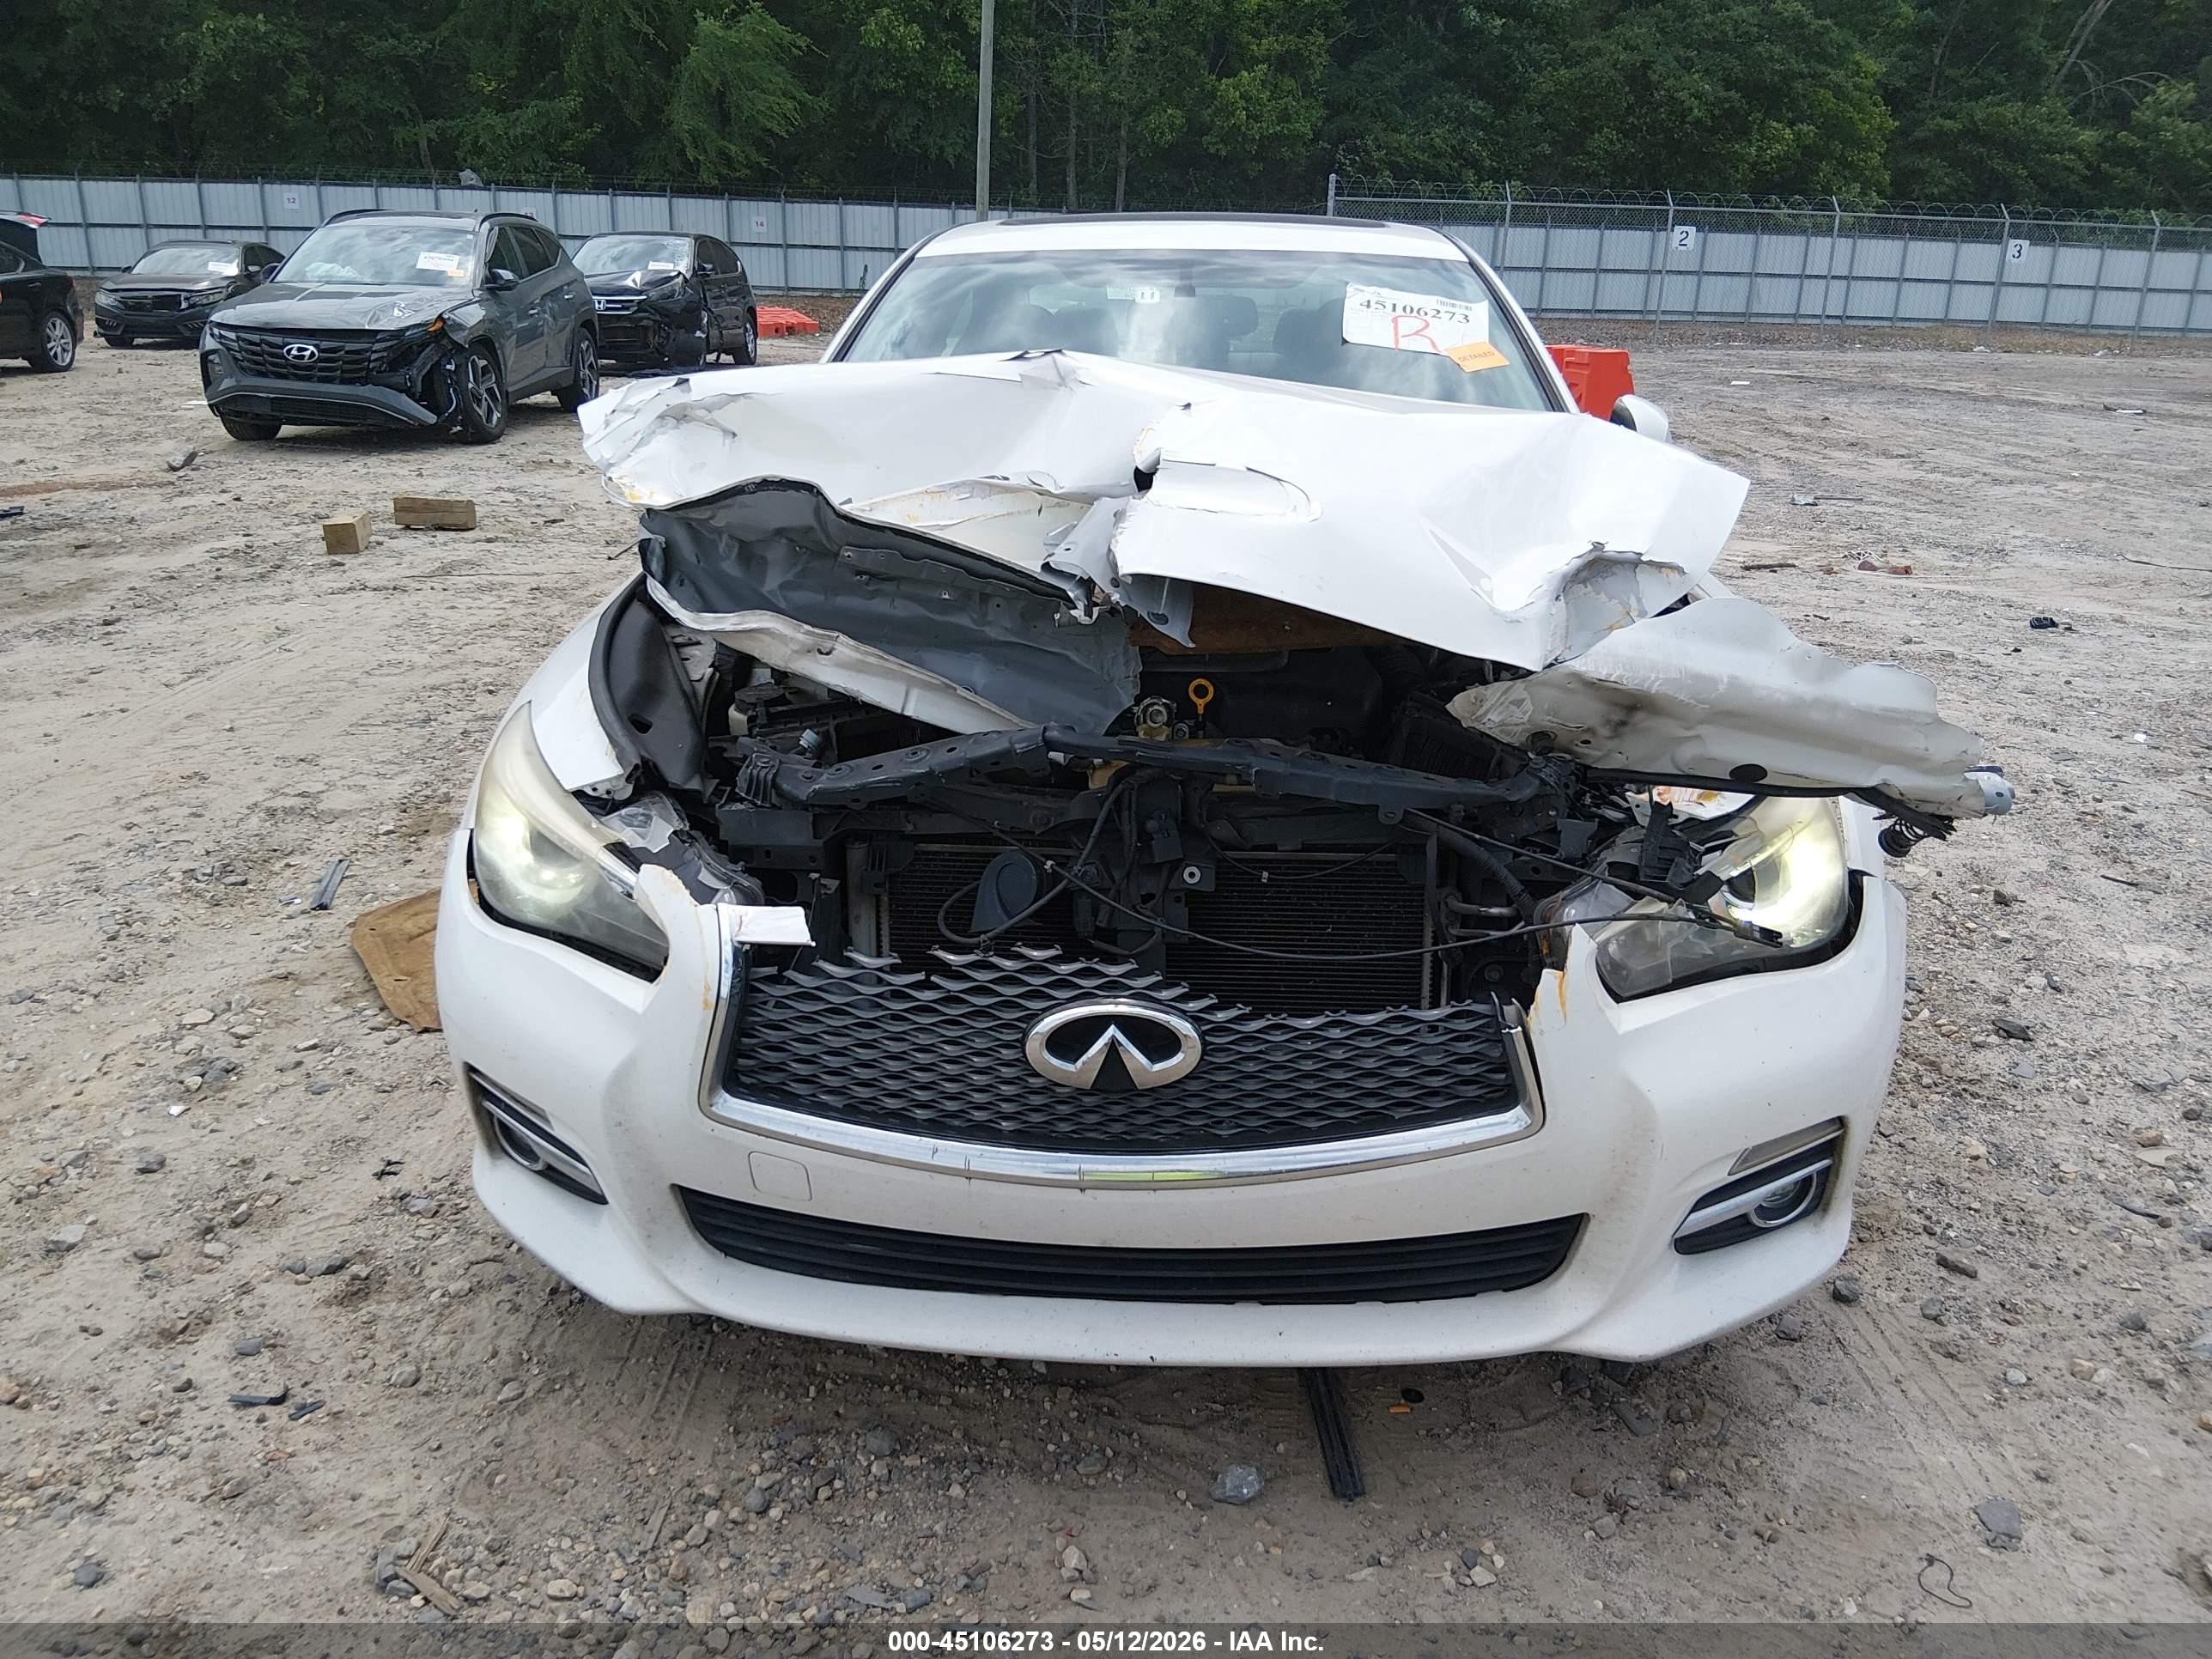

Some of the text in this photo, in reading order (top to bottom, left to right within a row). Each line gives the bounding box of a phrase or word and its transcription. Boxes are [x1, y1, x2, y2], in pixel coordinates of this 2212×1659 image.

[1678, 230, 1689, 246] 2
[2012, 243, 2023, 258] 3
[1359, 299, 1470, 325] 45106273
[1391, 314, 1442, 355] R
[1457, 350, 1495, 362] DETAILED
